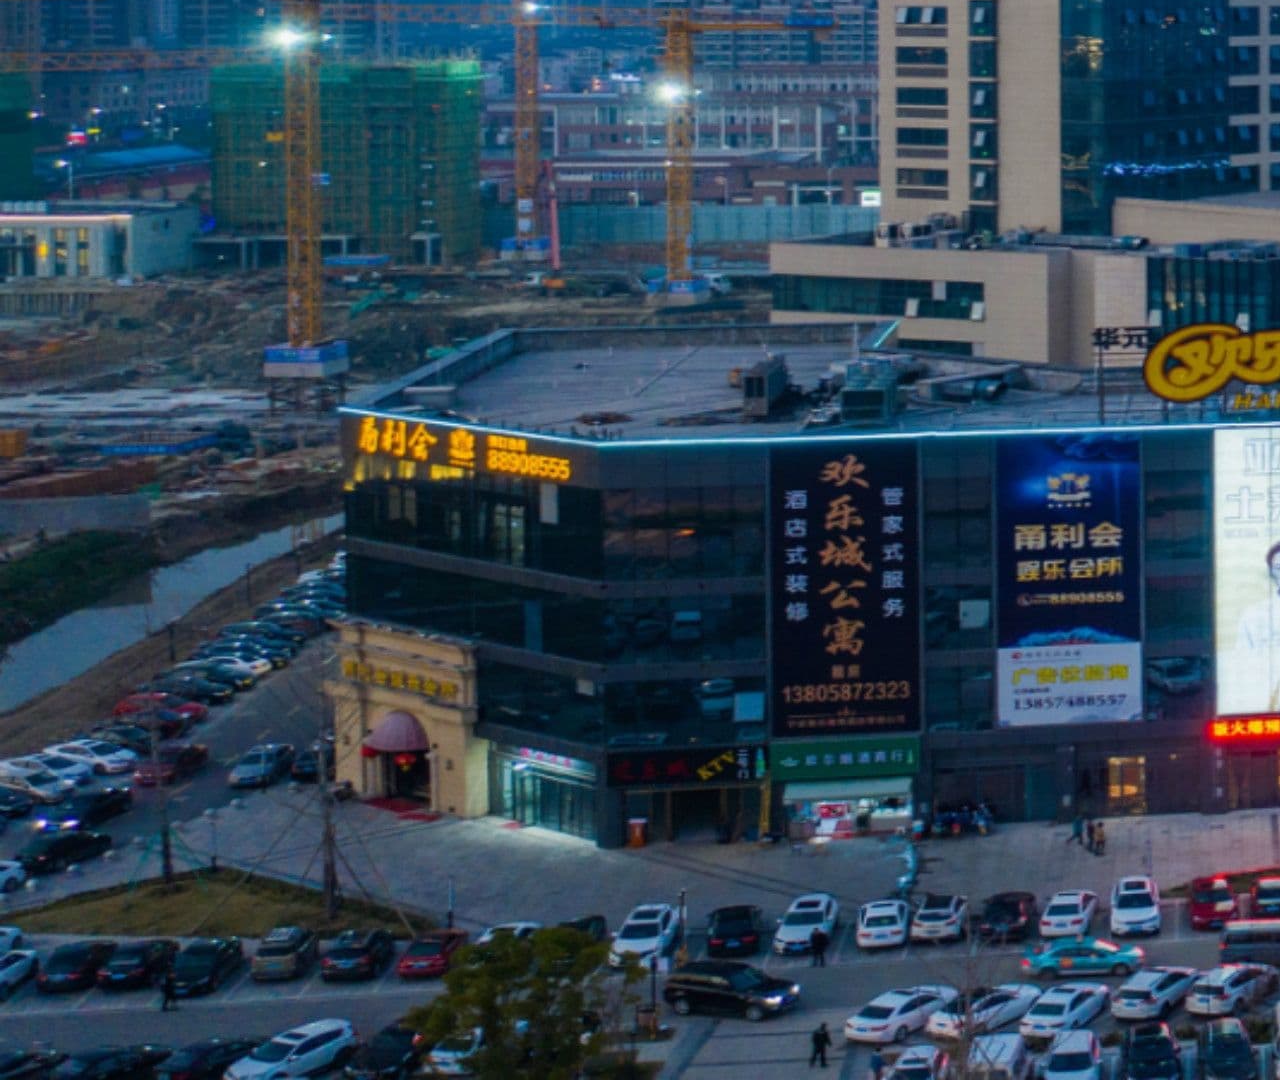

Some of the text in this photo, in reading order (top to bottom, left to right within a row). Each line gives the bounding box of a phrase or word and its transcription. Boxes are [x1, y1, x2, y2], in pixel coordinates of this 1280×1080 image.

[784, 490, 809, 621] 酒店式装修
[819, 454, 873, 655] 欢乐城公寓
[881, 487, 904, 618] 管家式服务
[782, 680, 911, 705] 13805872323
[697, 750, 736, 782] KTV
